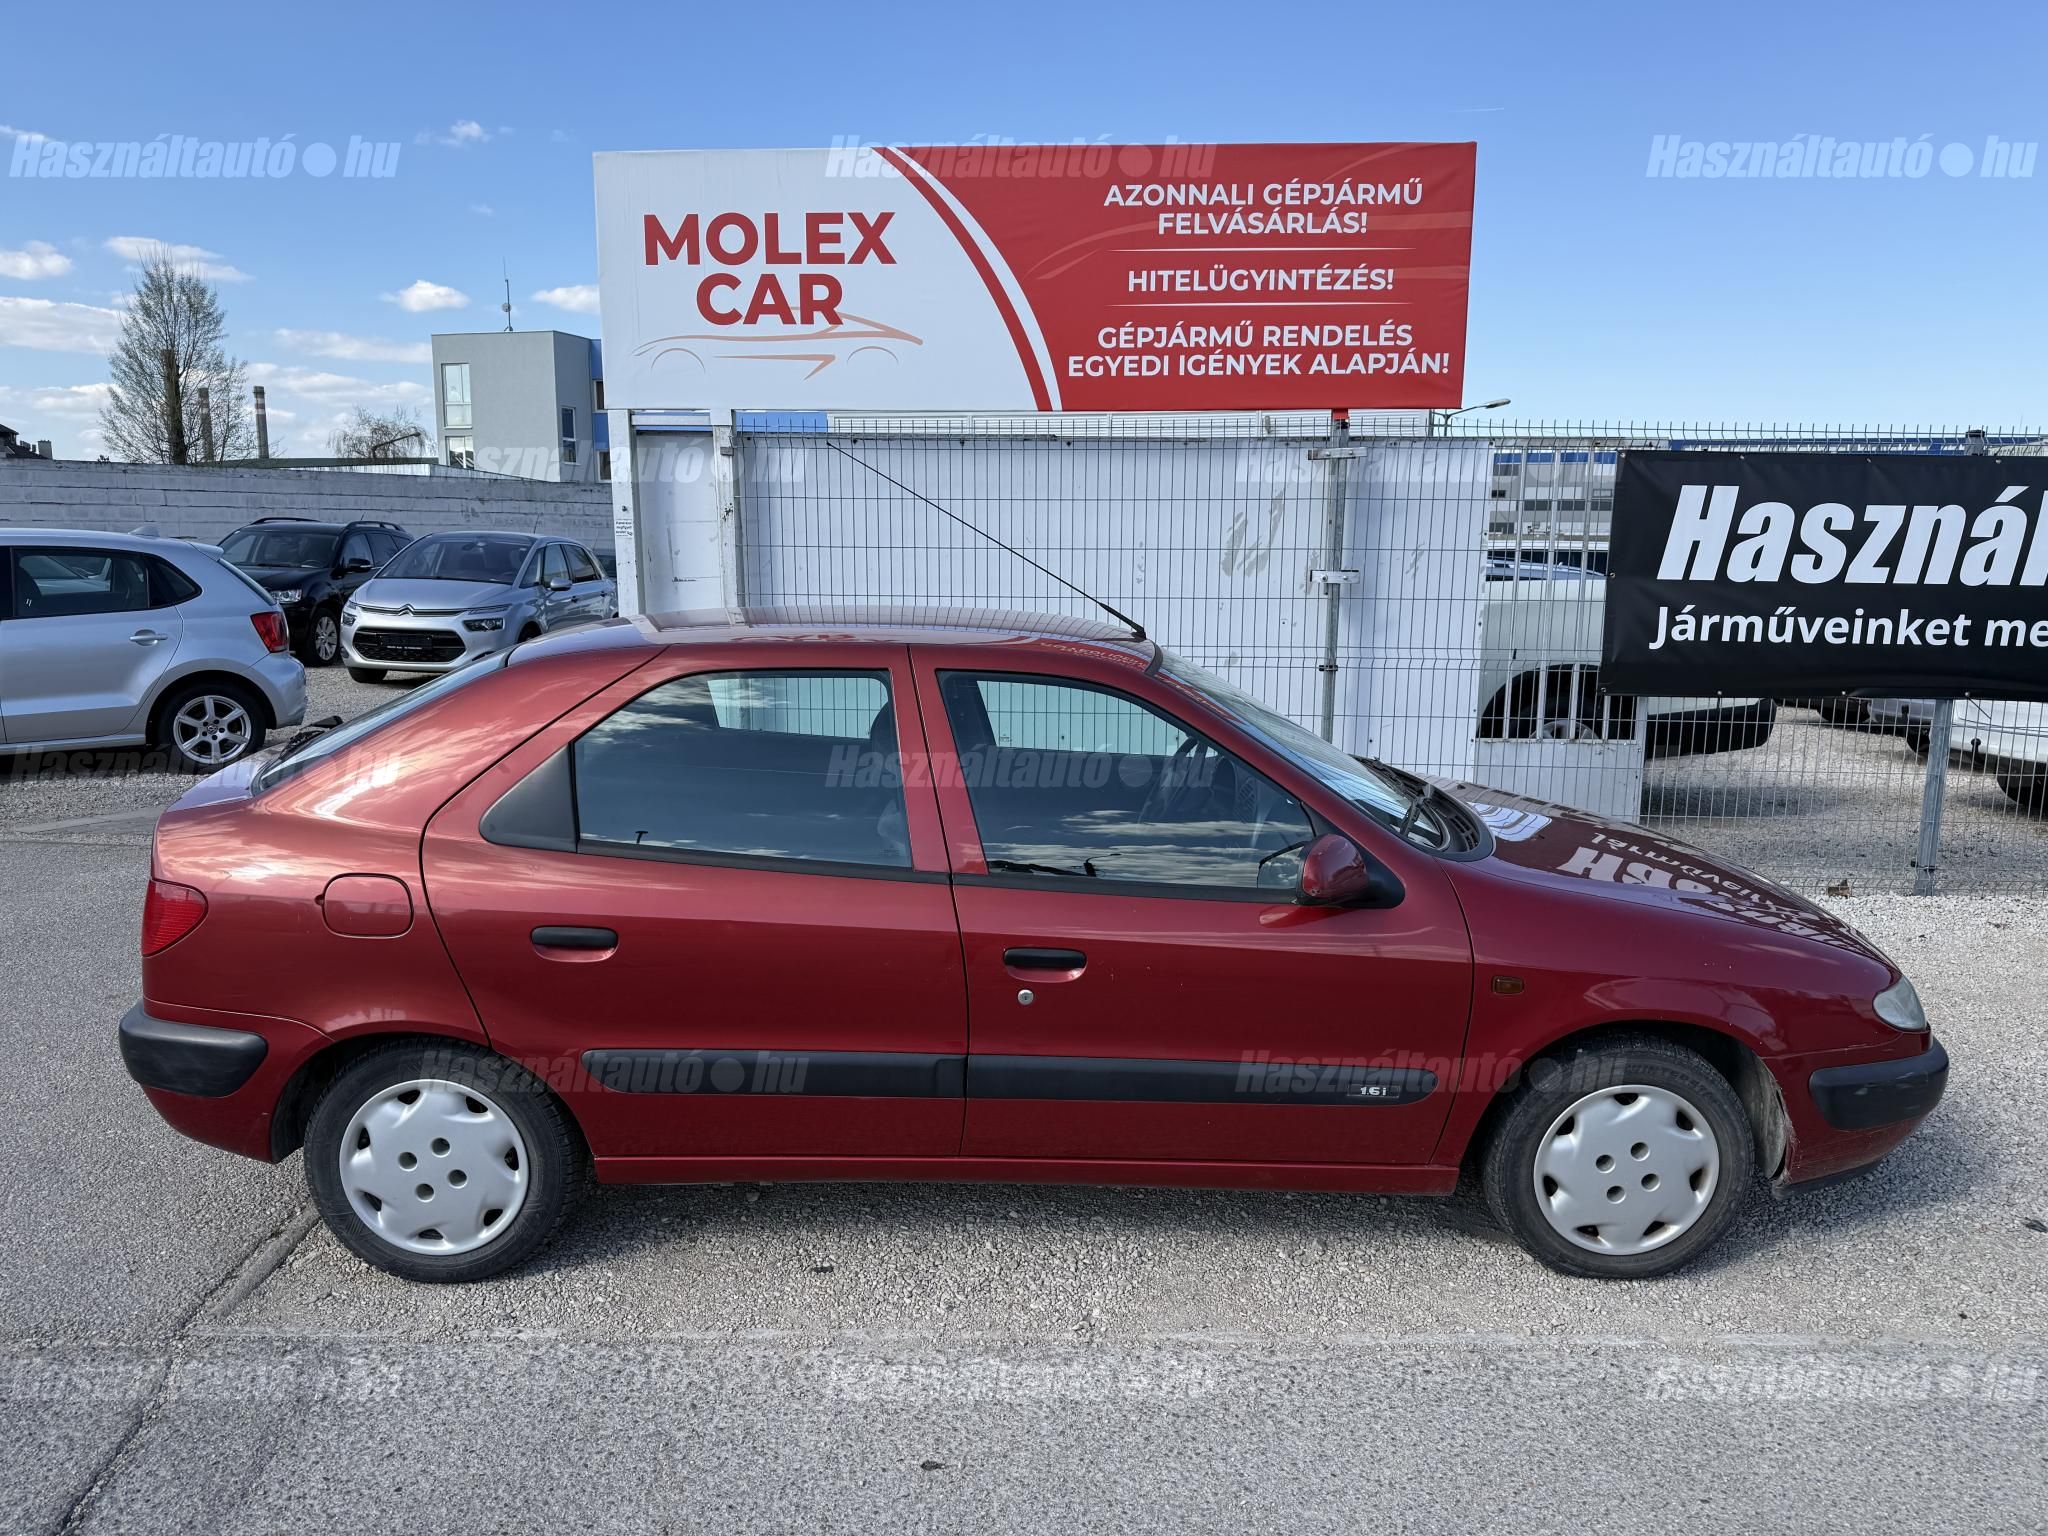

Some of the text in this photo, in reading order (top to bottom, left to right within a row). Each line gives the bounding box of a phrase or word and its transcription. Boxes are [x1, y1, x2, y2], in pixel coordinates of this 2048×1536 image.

[1104, 178, 1423, 207] AZONNALI GÉPJÁRMŰ
[1158, 207, 1367, 235] FELVÁSÁRLÁS!
[643, 212, 897, 266] MOLEX
[1128, 264, 1394, 292] HITELÜGYINTÉZÉS!
[696, 272, 844, 326] CAR
[1097, 319, 1413, 349] GÉPJÁRMŰ RENDELÉS
[1068, 347, 1449, 377] EGYEDI IGÉNYEK ALAPJÁN!
[1649, 605, 1971, 649] Járműveinket
